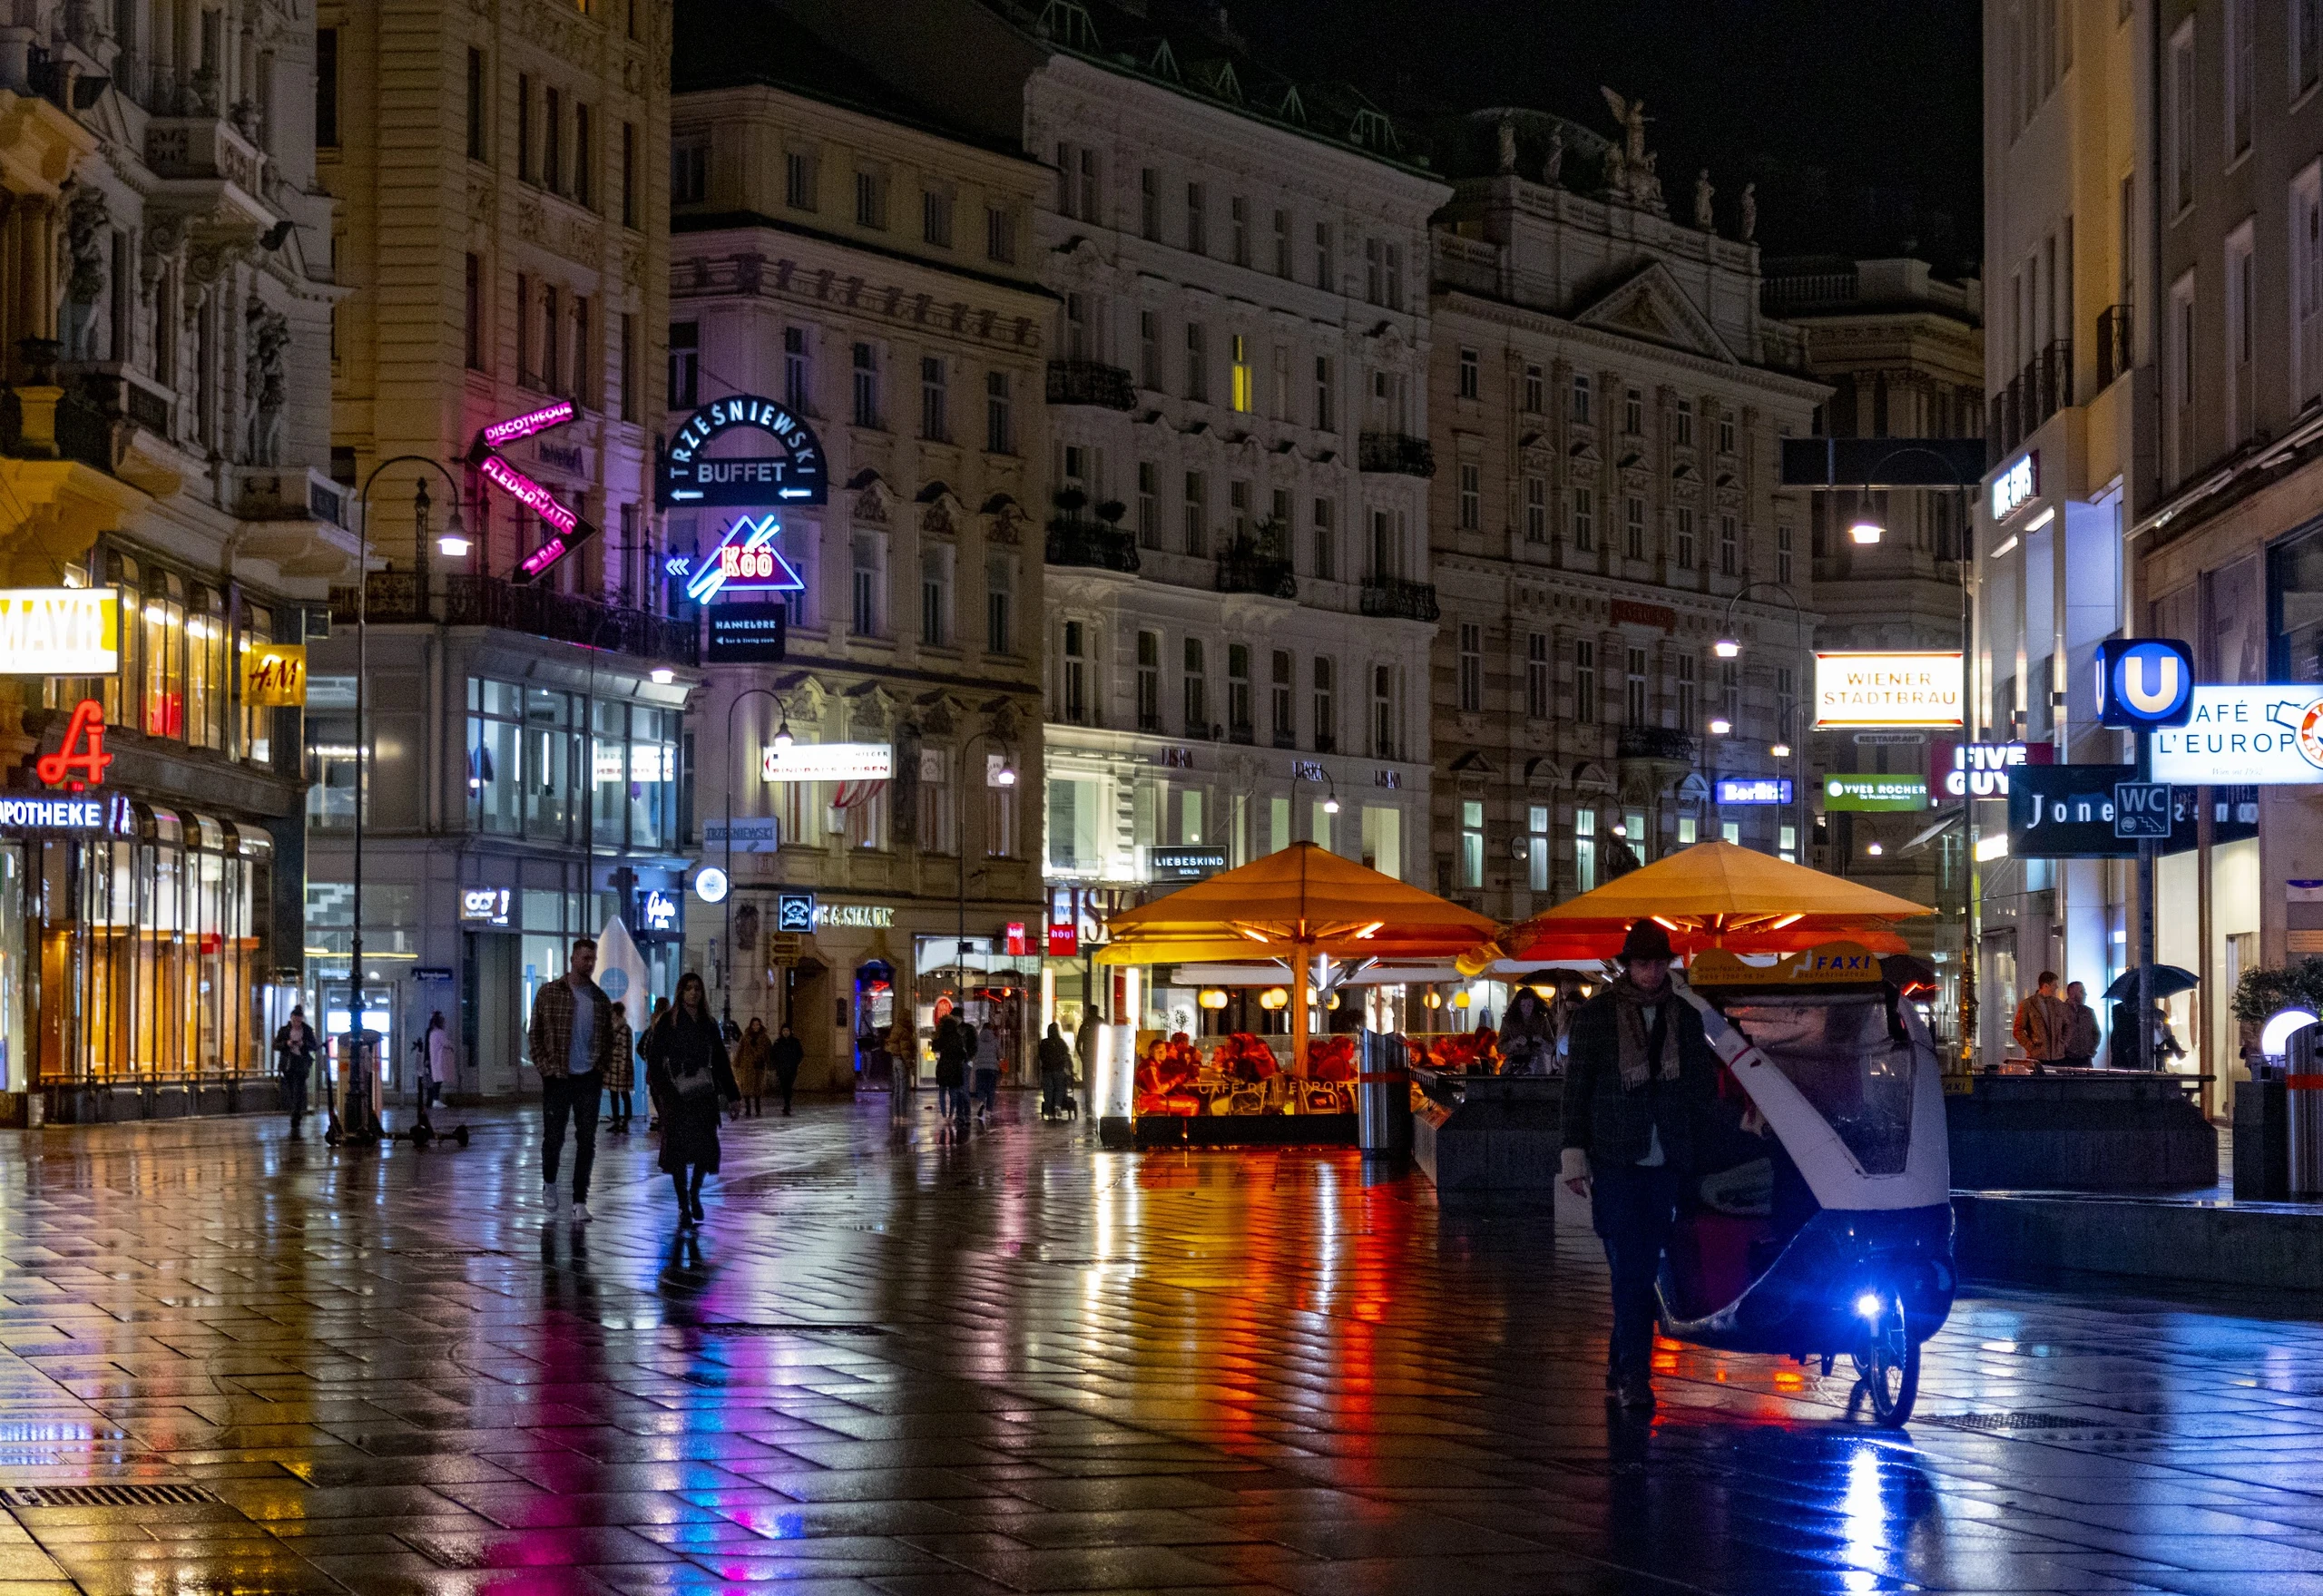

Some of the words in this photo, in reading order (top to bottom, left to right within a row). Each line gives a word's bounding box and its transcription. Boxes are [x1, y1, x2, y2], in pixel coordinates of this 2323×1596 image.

[484, 402, 573, 441] DISCOTHEQUE
[670, 400, 816, 479] TRZEŚNIEWSKI
[698, 462, 787, 484] BUFFET
[481, 458, 576, 535] FLEDERMAUS
[715, 620, 776, 630] HANNELORE
[249, 659, 299, 691] H&M
[1848, 672, 1931, 685] WIENER
[2124, 656, 2179, 714] U
[2196, 700, 2249, 723] AFÉ
[1858, 735, 1920, 743] RESTAURANT
[2160, 733, 2295, 754] L'EUROP
[1161, 748, 1193, 769] LISKA
[1955, 746, 2028, 770] FIVE
[1374, 769, 1402, 789] LISKA
[1845, 785, 1875, 794] YVES
[1877, 785, 1927, 795] ROCHER
[1946, 770, 2009, 796] GUY
[2121, 788, 2165, 812] WC
[2026, 794, 2115, 829] Jone
[1155, 857, 1224, 867] LIEBESKIND
[1051, 928, 1074, 940] högl
[1817, 955, 1871, 970] FAXI
